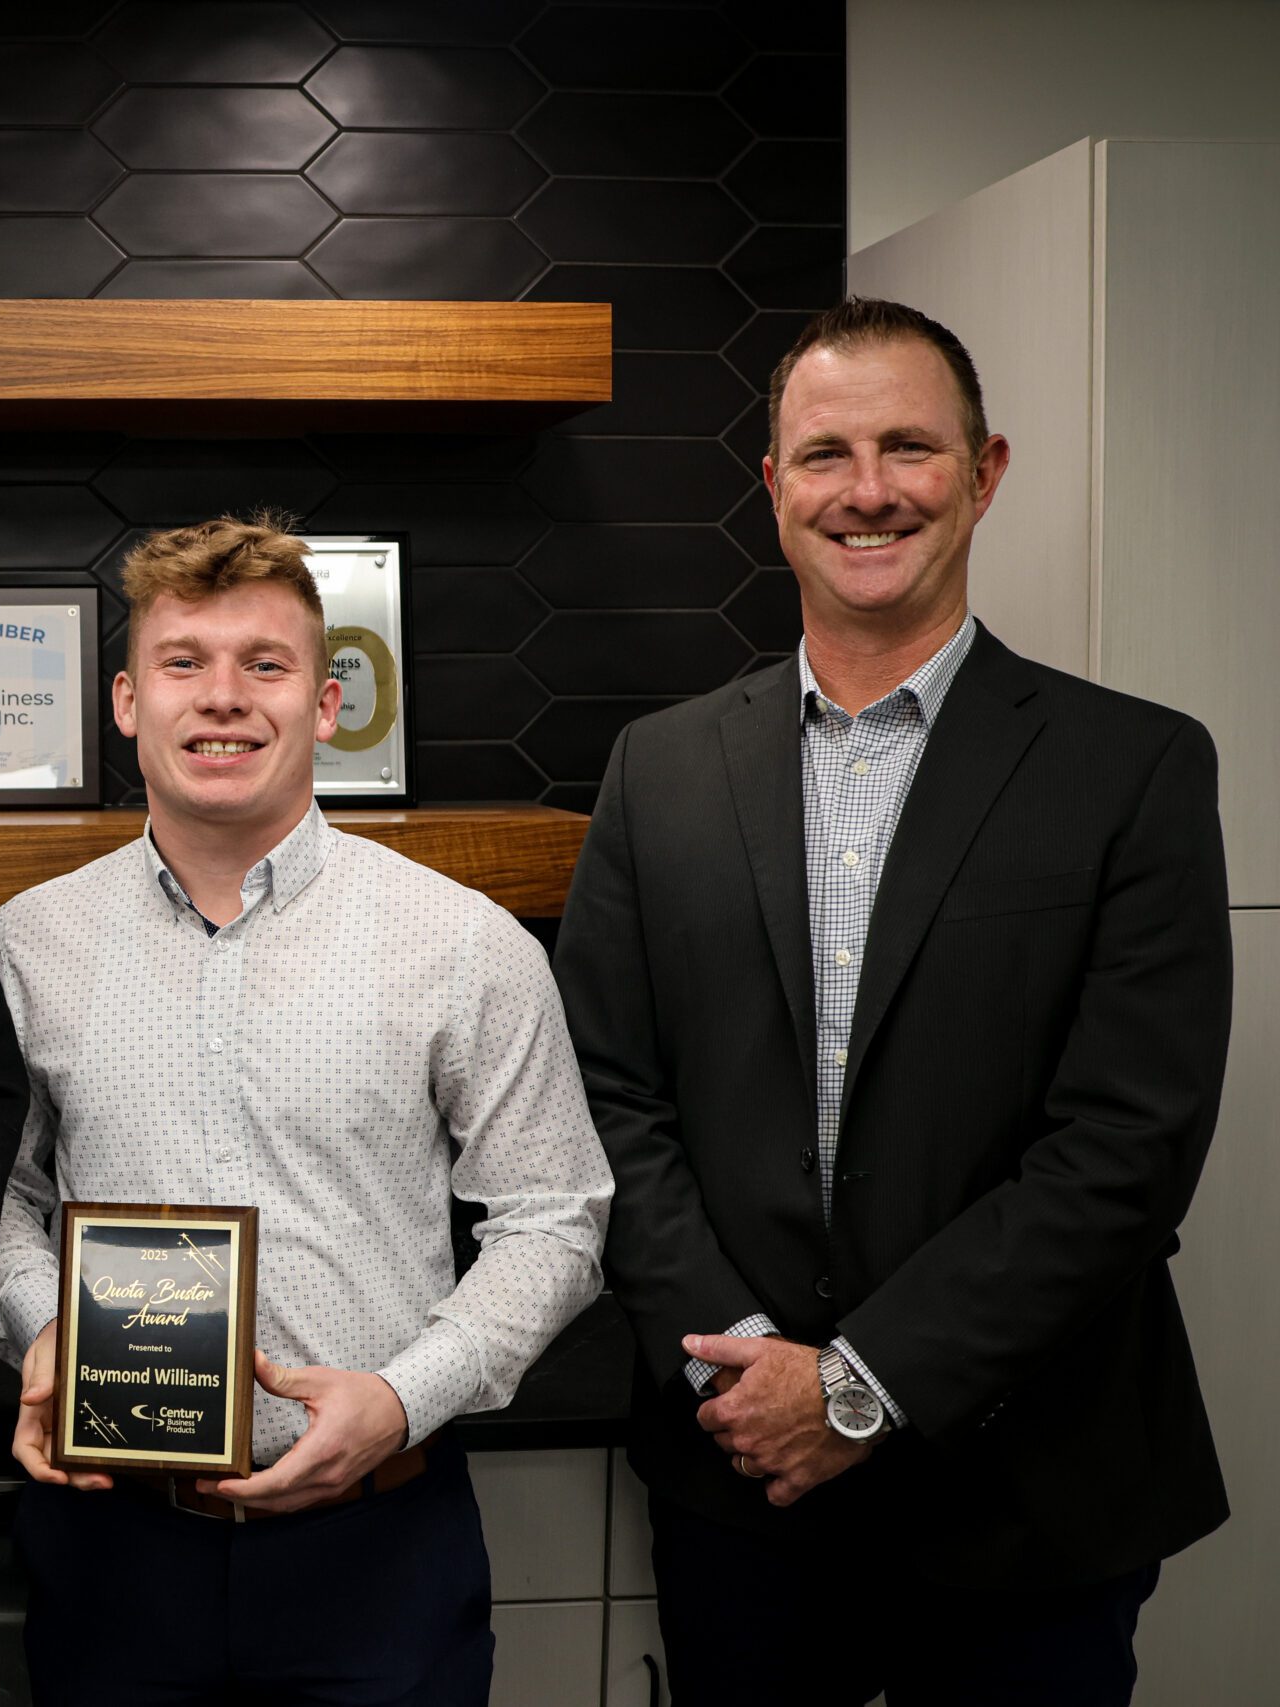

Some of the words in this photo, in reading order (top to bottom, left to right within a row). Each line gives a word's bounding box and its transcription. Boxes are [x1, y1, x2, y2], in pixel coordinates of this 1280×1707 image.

[328, 659, 361, 669] INESS
[140, 1250, 168, 1260] 2025
[92, 1276, 148, 1304] Quota
[149, 1278, 214, 1305] Buster
[122, 1303, 190, 1329] Award
[128, 1344, 163, 1352] Presented
[80, 1365, 150, 1386] Raymond
[154, 1368, 220, 1387] Williams
[160, 1406, 204, 1421] Century
[168, 1419, 195, 1427] Business
